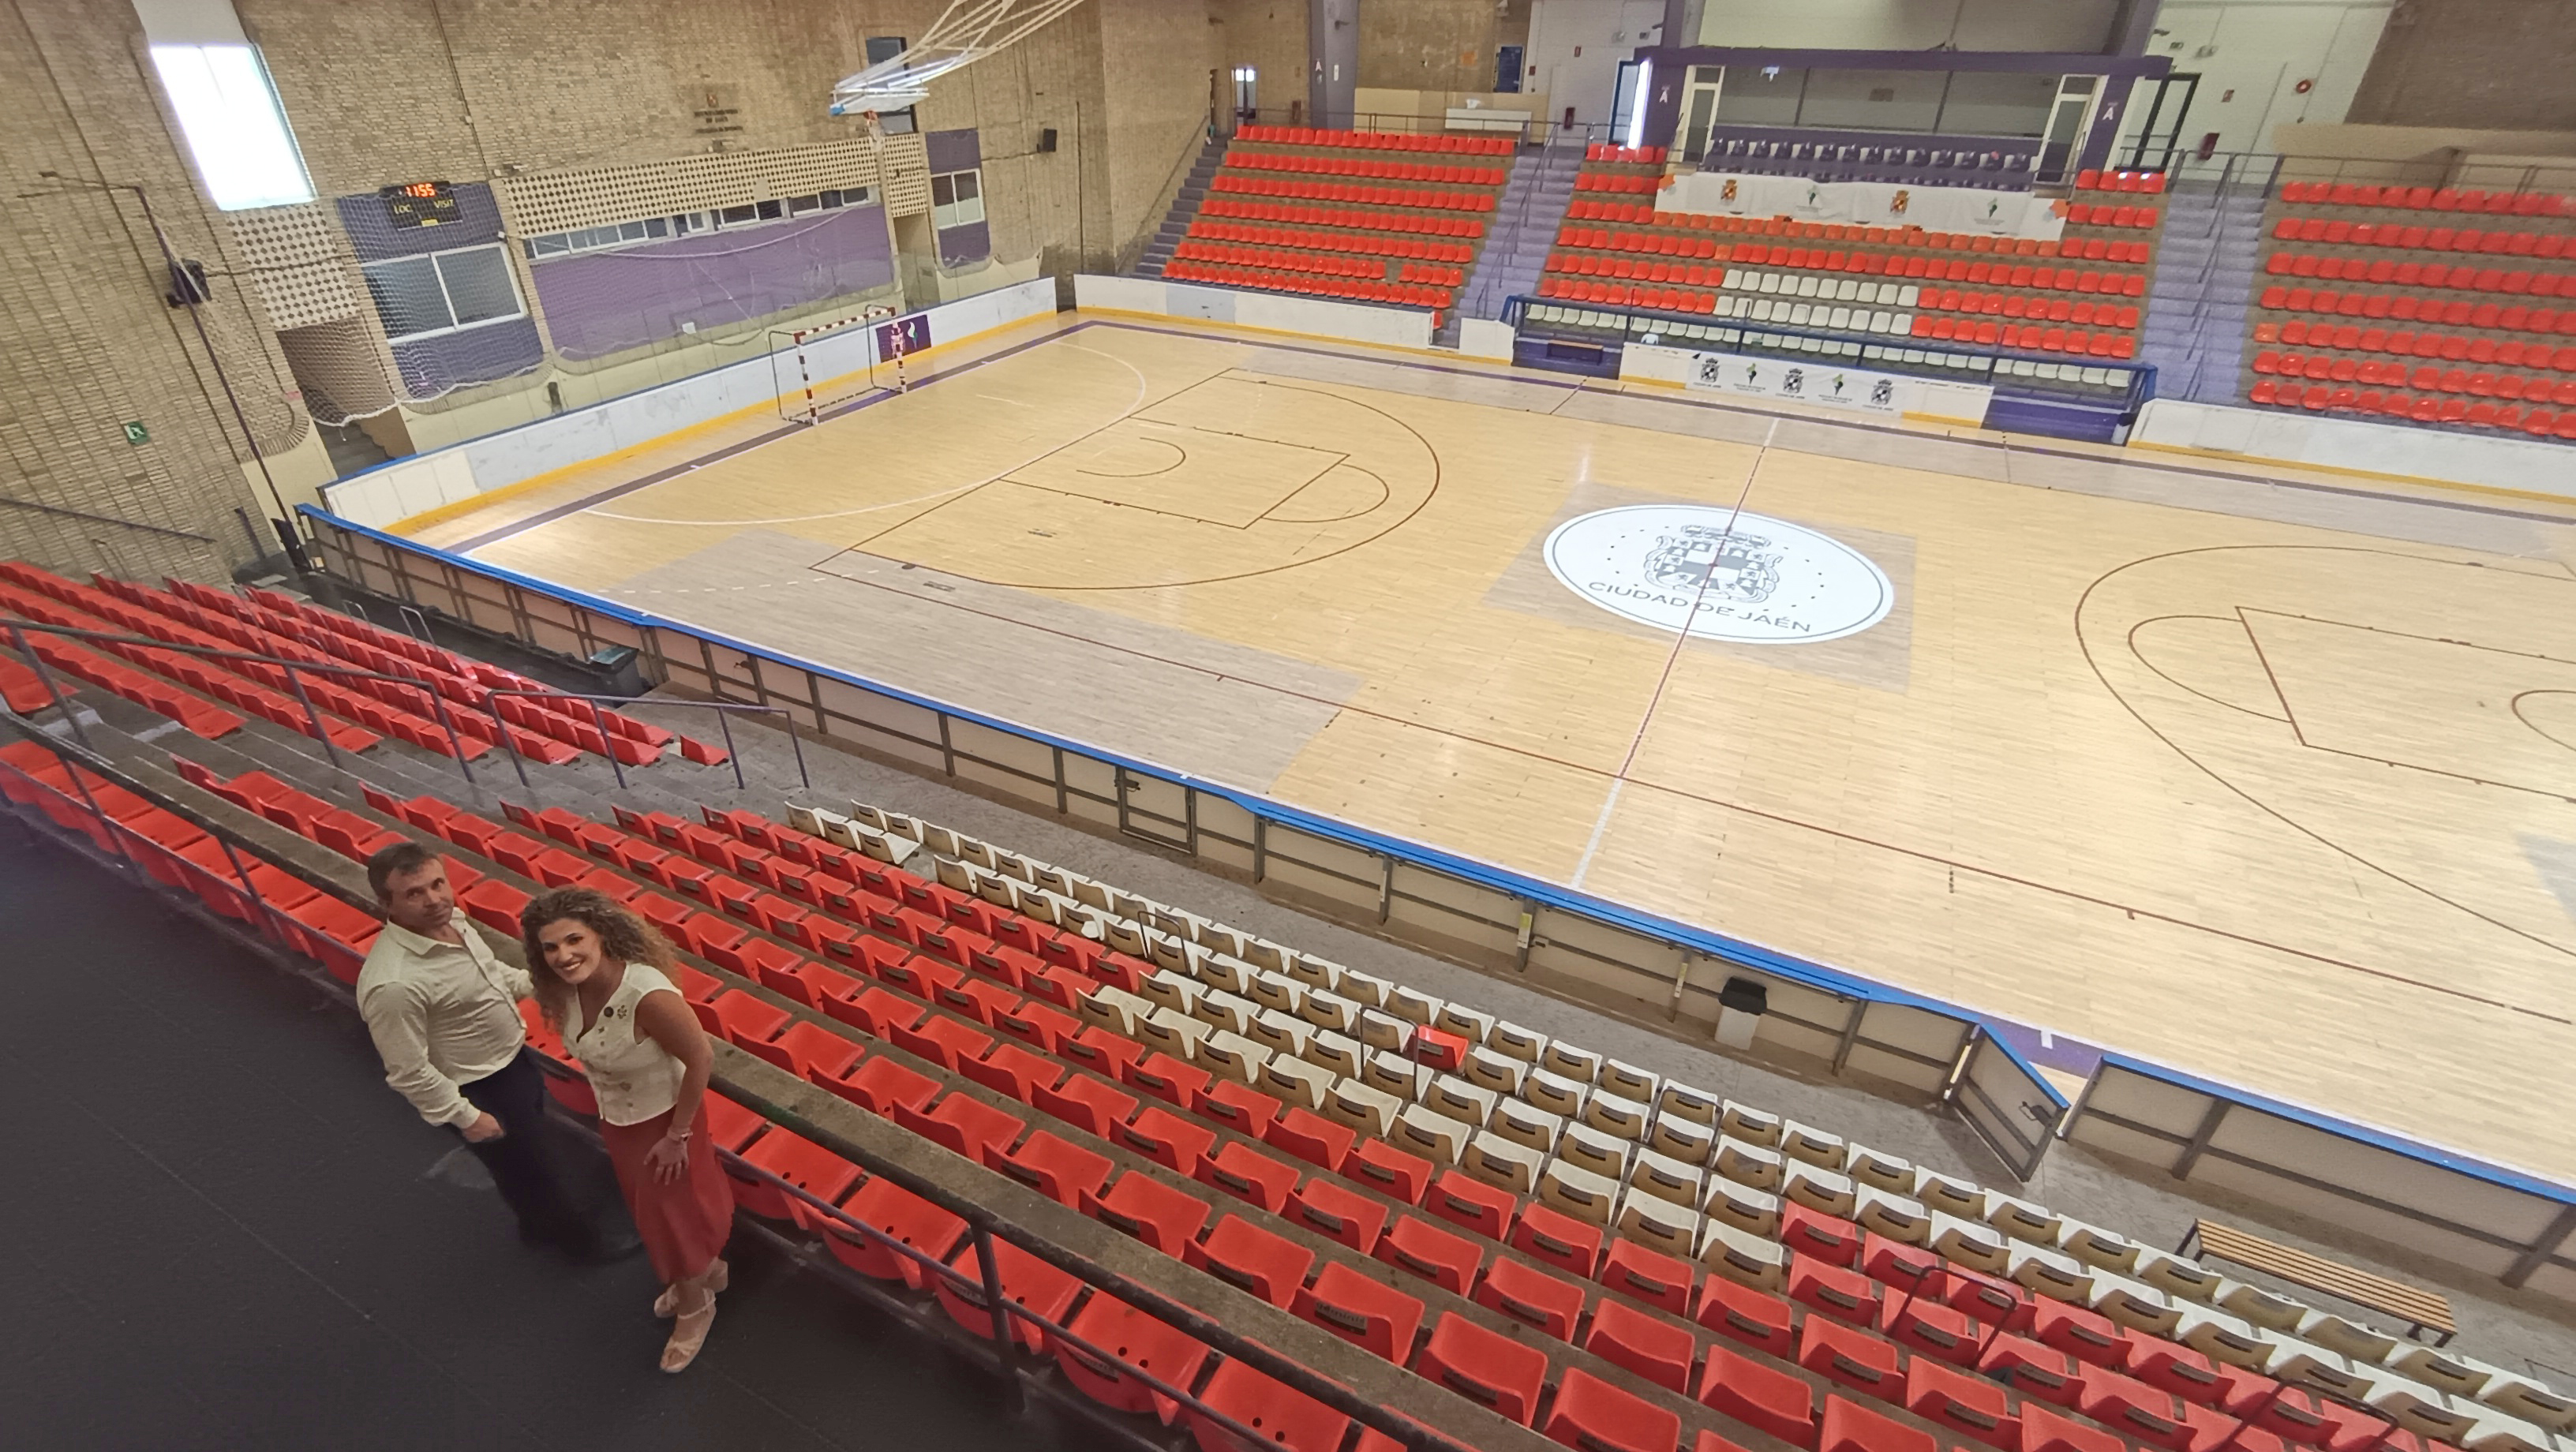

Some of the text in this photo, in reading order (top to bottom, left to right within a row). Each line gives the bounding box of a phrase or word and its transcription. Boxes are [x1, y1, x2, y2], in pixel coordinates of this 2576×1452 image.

[1589, 582, 1810, 633] CIUDAD DE JAÉN
